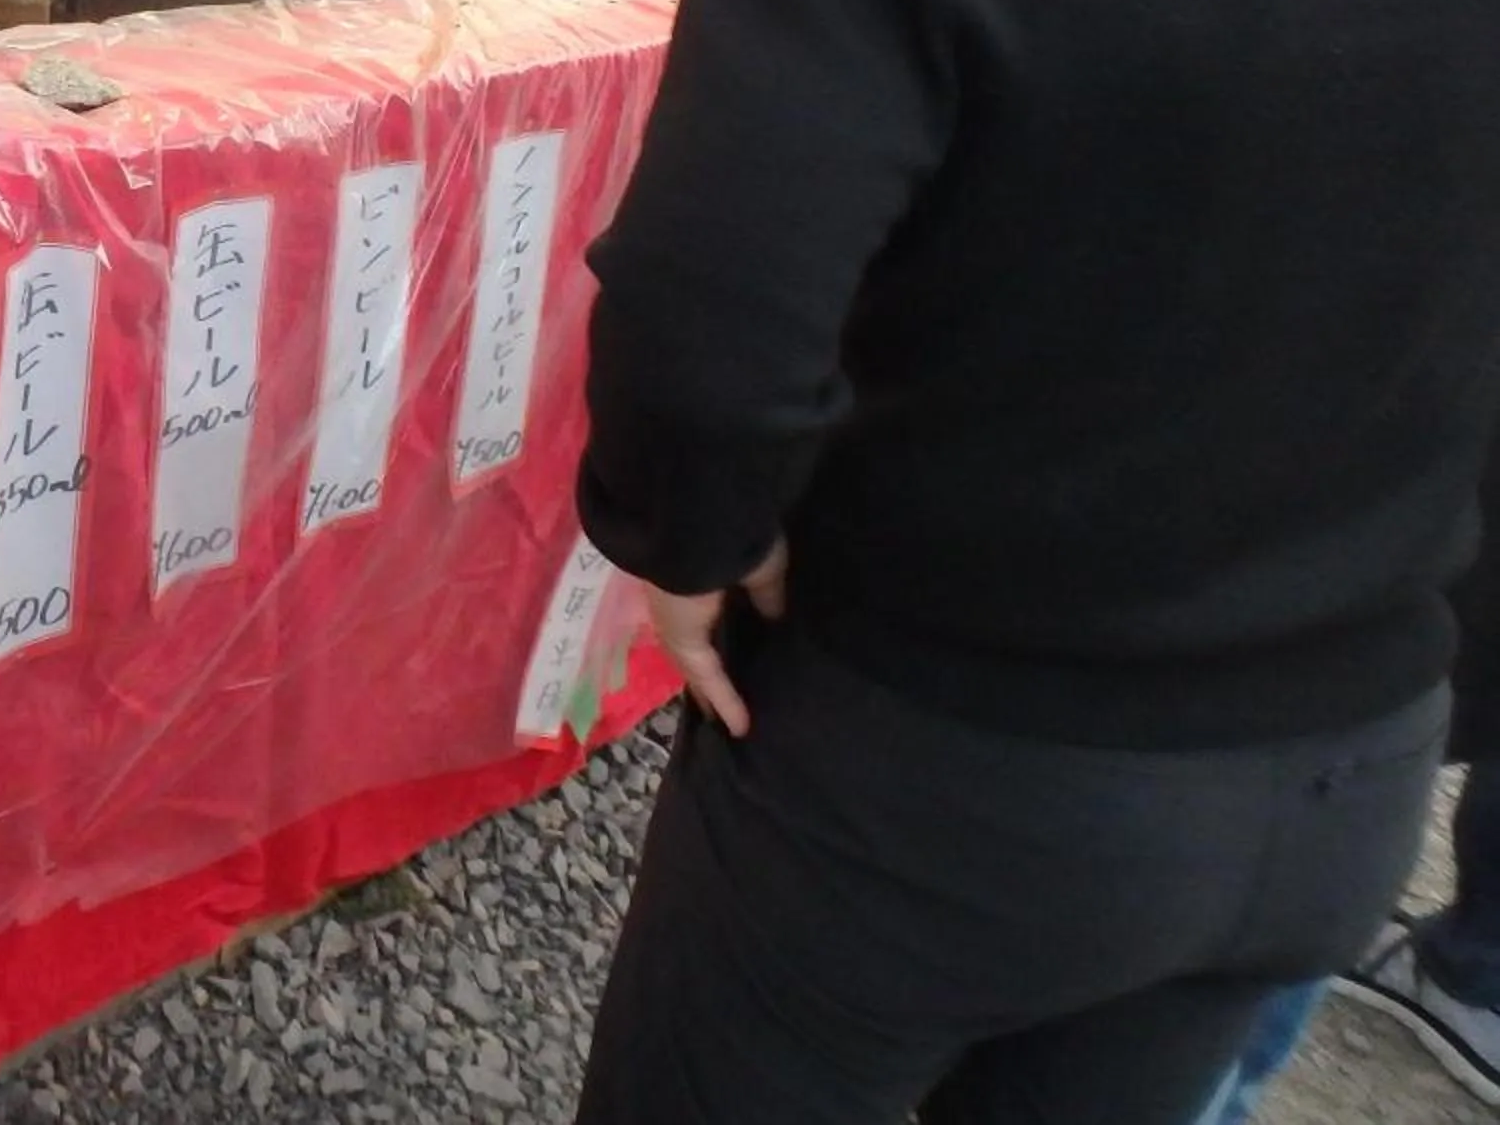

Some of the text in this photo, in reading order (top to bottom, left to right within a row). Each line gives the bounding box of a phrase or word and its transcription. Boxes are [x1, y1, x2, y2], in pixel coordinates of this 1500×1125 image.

[4, 272, 66, 463] 缶ビール
[183, 224, 245, 397] 缶ビール
[338, 183, 399, 398] ビンビール
[479, 145, 537, 412] ノンアルコールビール
[162, 380, 260, 448] 500ml
